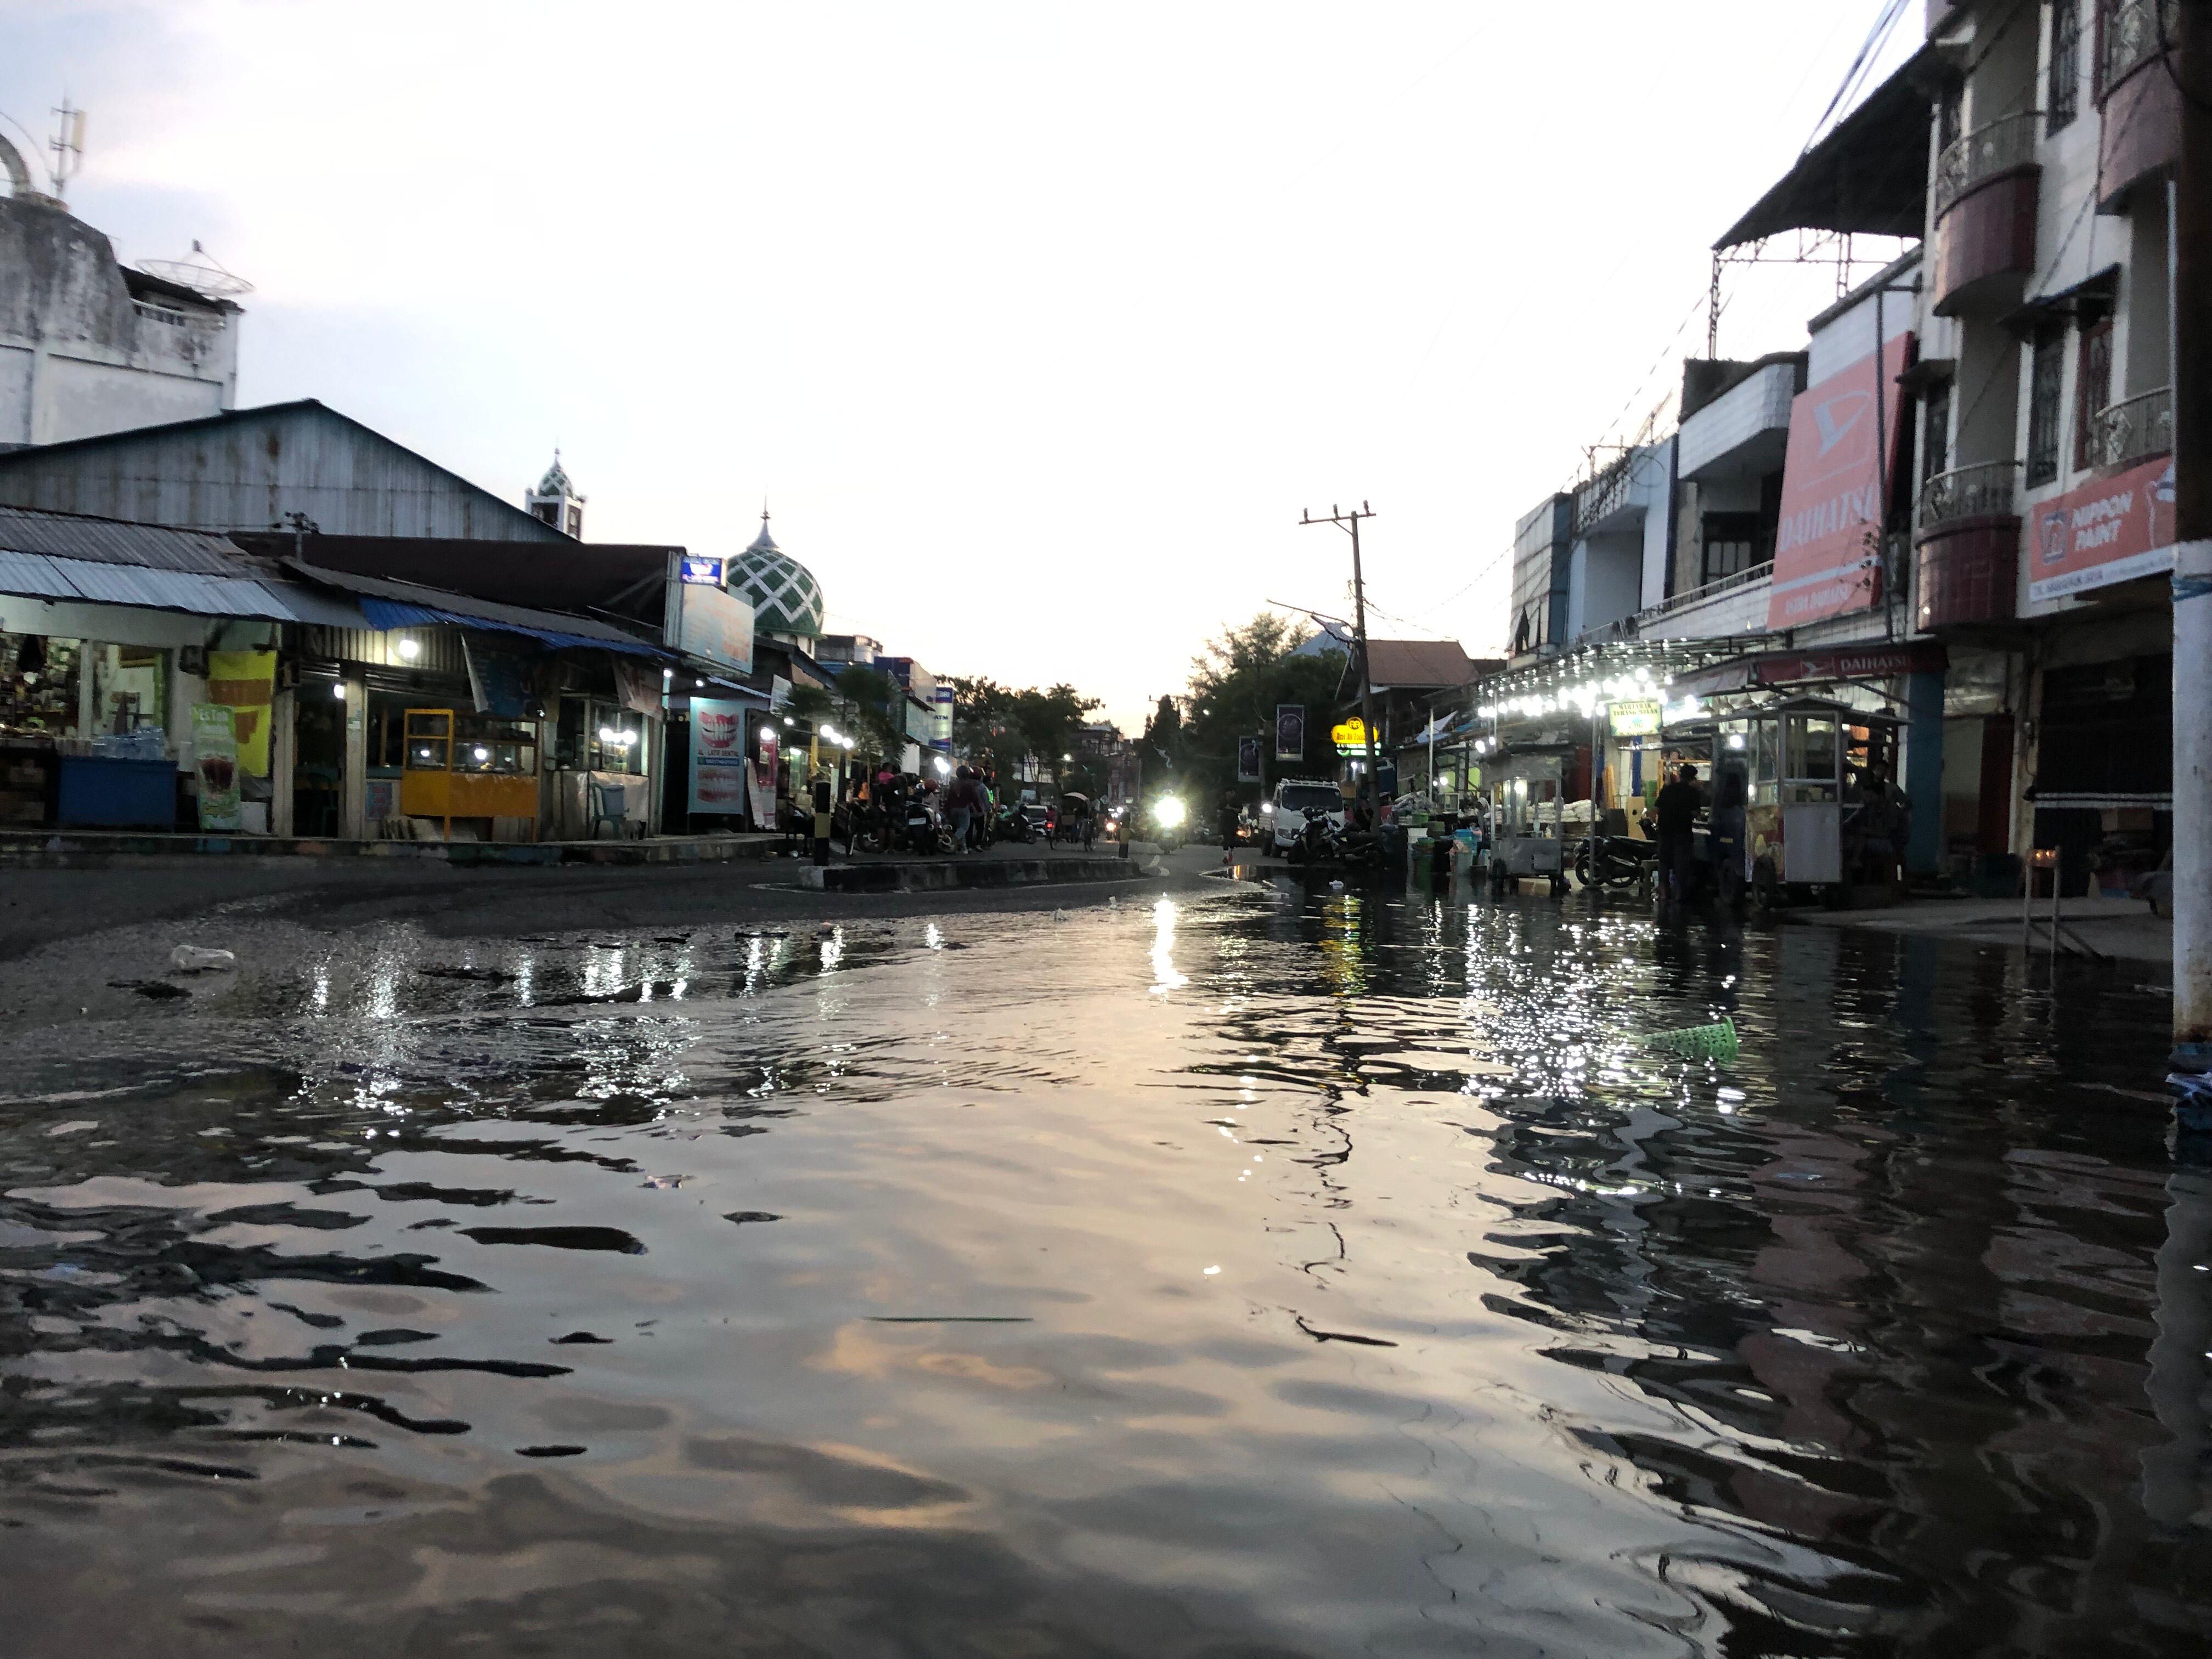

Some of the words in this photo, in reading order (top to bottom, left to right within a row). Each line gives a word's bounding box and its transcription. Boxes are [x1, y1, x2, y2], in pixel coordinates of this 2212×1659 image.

[1779, 485, 1874, 553] DAIHATSU
[2071, 492, 2133, 528] NIPPON
[2074, 519, 2121, 551] PAINT
[1841, 657, 1906, 672] DAIHATSU
